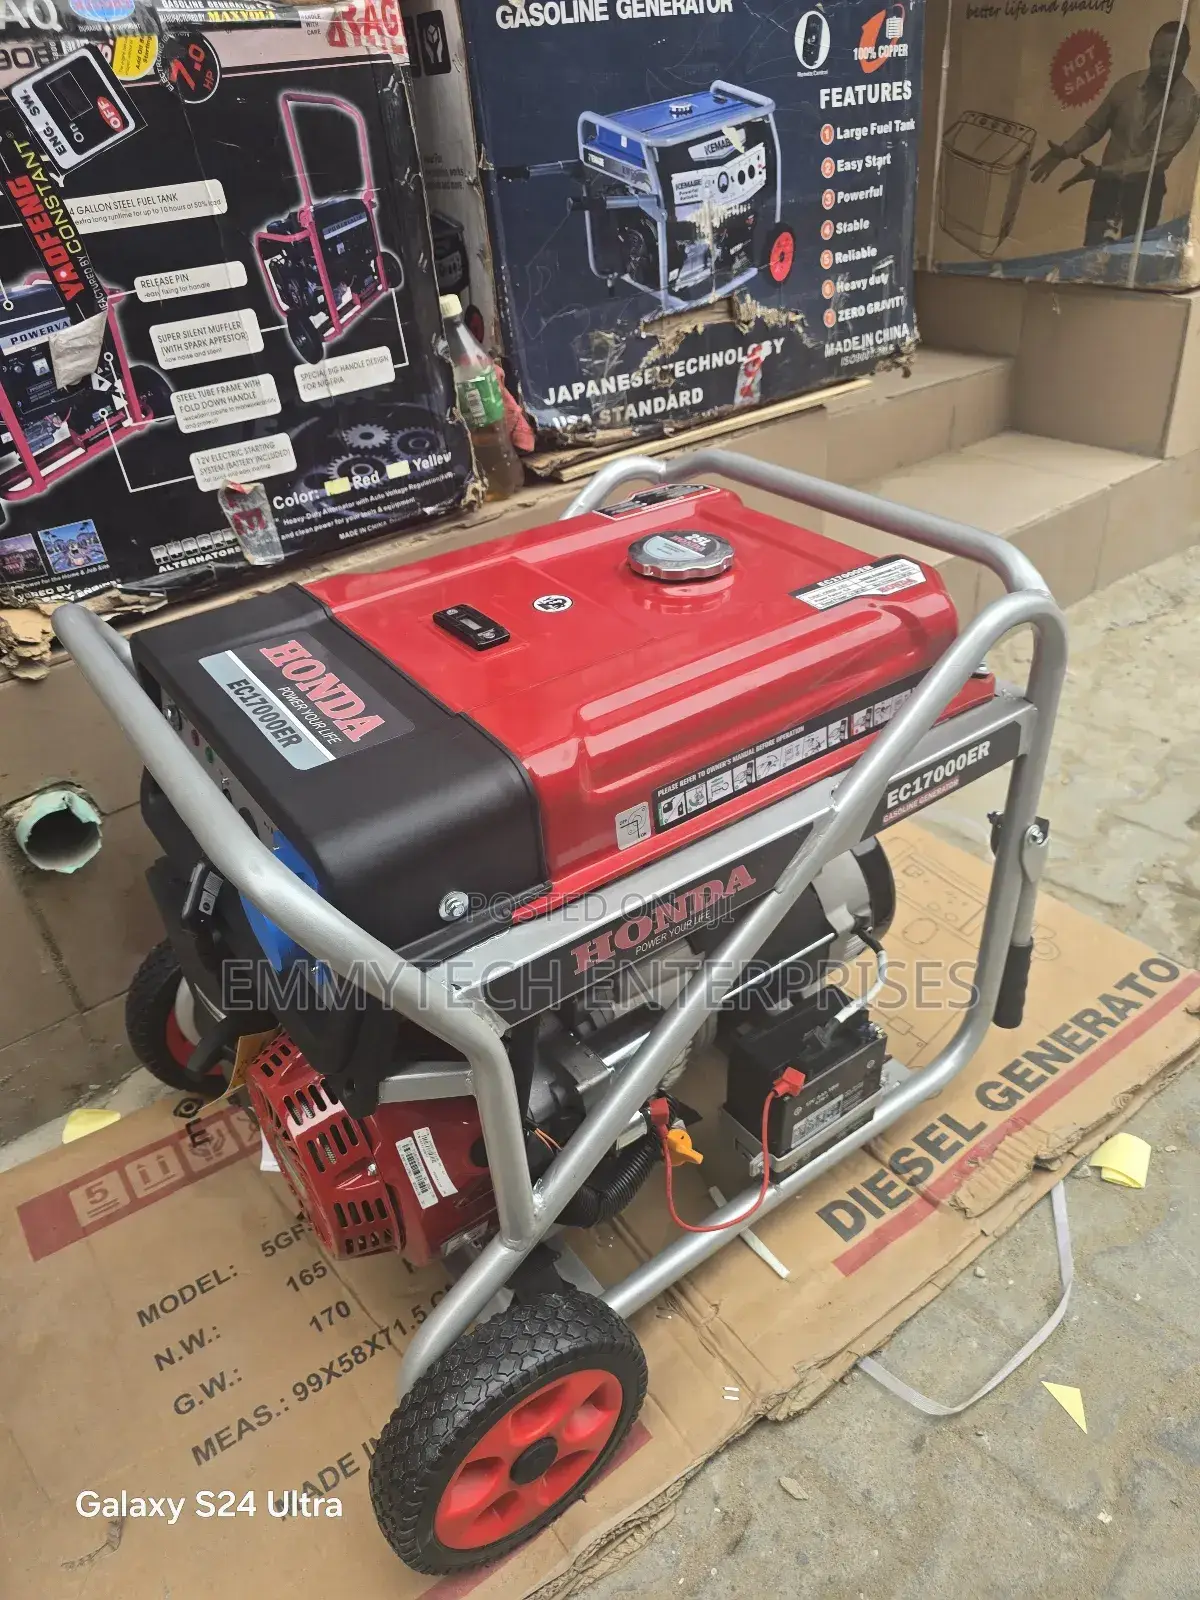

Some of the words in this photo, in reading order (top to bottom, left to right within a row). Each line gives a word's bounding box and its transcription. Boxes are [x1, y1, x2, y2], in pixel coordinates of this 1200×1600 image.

[495, 0, 609, 29] GASOLINE
[965, 3, 1001, 20] better
[1004, 0, 1030, 21] life
[1030, 0, 1059, 15] and
[1061, 0, 1115, 18] quality
[853, 47, 877, 61] 100%
[878, 44, 909, 59] COPPER
[1062, 44, 1096, 77] HOT
[169, 43, 205, 91] 7.0
[1063, 60, 1107, 95] SALE
[203, 70, 214, 92] HP
[20, 89, 41, 117] SW.
[819, 80, 912, 110] FEATURES
[98, 99, 123, 129] OFF
[43, 121, 67, 156] ENG.
[69, 123, 85, 143] On
[836, 125, 868, 141] Large
[870, 121, 893, 136] Fuel
[893, 117, 916, 132] Tank
[836, 158, 865, 173] Easy
[865, 153, 892, 168] Start
[13, 139, 82, 254] CONSTANT
[77, 202, 112, 215] GALLON
[114, 198, 136, 210] STEEL
[137, 196, 156, 207] FUEL
[157, 193, 178, 204] TANK
[837, 184, 883, 204] Powerful
[92, 212, 107, 224] long
[108, 211, 133, 222] runtime
[133, 210, 142, 218] for
[143, 209, 152, 220] up
[152, 207, 159, 215] to
[161, 206, 169, 215] 10
[169, 203, 186, 213] hours
[194, 200, 207, 209] 50%
[835, 217, 870, 236] Stable
[77, 254, 90, 268] BY
[834, 245, 878, 265] Reliable
[83, 267, 108, 311] FACTURED
[140, 275, 174, 289] RELEASE
[175, 273, 190, 284] PIN
[161, 285, 179, 296] fixing
[179, 285, 188, 293] for
[189, 282, 211, 292] handle
[836, 276, 868, 294] Heavy
[868, 272, 890, 288] duty
[837, 304, 866, 323] ZERO
[10, 320, 69, 345] POWERVA
[157, 331, 182, 344] SUPER
[182, 327, 207, 340] SILENT
[208, 320, 242, 333] MUFFLER
[183, 338, 208, 351] SPARK
[824, 336, 859, 359] MADE
[874, 322, 910, 346] CHINA
[194, 350, 206, 358] and
[300, 368, 327, 381] SPECIAL
[340, 358, 365, 373] HANDLE
[365, 354, 389, 367] DESIGN
[176, 392, 197, 404] STEEL
[197, 387, 215, 399] TUBE
[216, 382, 242, 395] FRAME
[242, 378, 262, 389] WITH
[303, 381, 317, 391] FOR
[179, 402, 201, 414] FOLD
[201, 397, 227, 410] DOWN
[228, 390, 258, 403] HANDLE
[599, 387, 704, 426] STANDARD
[210, 448, 243, 461] ELECTRIC
[272, 488, 320, 510] Color:
[352, 470, 380, 490] Red
[355, 497, 370, 507] with
[370, 493, 386, 503] Auto
[281, 531, 295, 541] and
[295, 526, 314, 537] clean
[334, 518, 344, 526] for
[338, 529, 359, 541] MADE
[158, 546, 242, 573] ALTERNATORS
[56, 584, 71, 593] BY
[259, 639, 385, 743] HONDA
[225, 678, 303, 749] EC17000ER
[277, 686, 308, 711] POWER
[301, 709, 327, 733] YOUR
[319, 726, 342, 746] LIFE
[657, 782, 679, 797] PLEASE
[679, 774, 697, 787] REFER
[698, 770, 706, 779] TO
[706, 758, 731, 776] OWNER'S
[732, 747, 756, 764] MANUAL
[756, 739, 776, 753] BEFORE
[776, 725, 805, 743] OPERATION
[886, 740, 991, 810] EC17000ER
[882, 796, 918, 824] GASOLINE
[918, 778, 960, 805] GENERATOR
[570, 864, 757, 976] HONDA
[635, 931, 668, 956] POWER
[669, 919, 693, 939] YOUR
[693, 909, 712, 930] LIFE
[815, 1112, 989, 1243] DIESEL
[974, 957, 1181, 1113] GENERATO
[85, 1180, 109, 1206] 5
[136, 1263, 239, 1328] MODEL:
[154, 1324, 222, 1372] N.W.:
[285, 1260, 328, 1294] 165
[173, 1368, 243, 1417] G.W.:
[308, 1300, 352, 1335] 170
[190, 1396, 291, 1467] MEAS.:
[291, 1304, 428, 1402] 99X58X71.5
[276, 1451, 361, 1522] MADE
